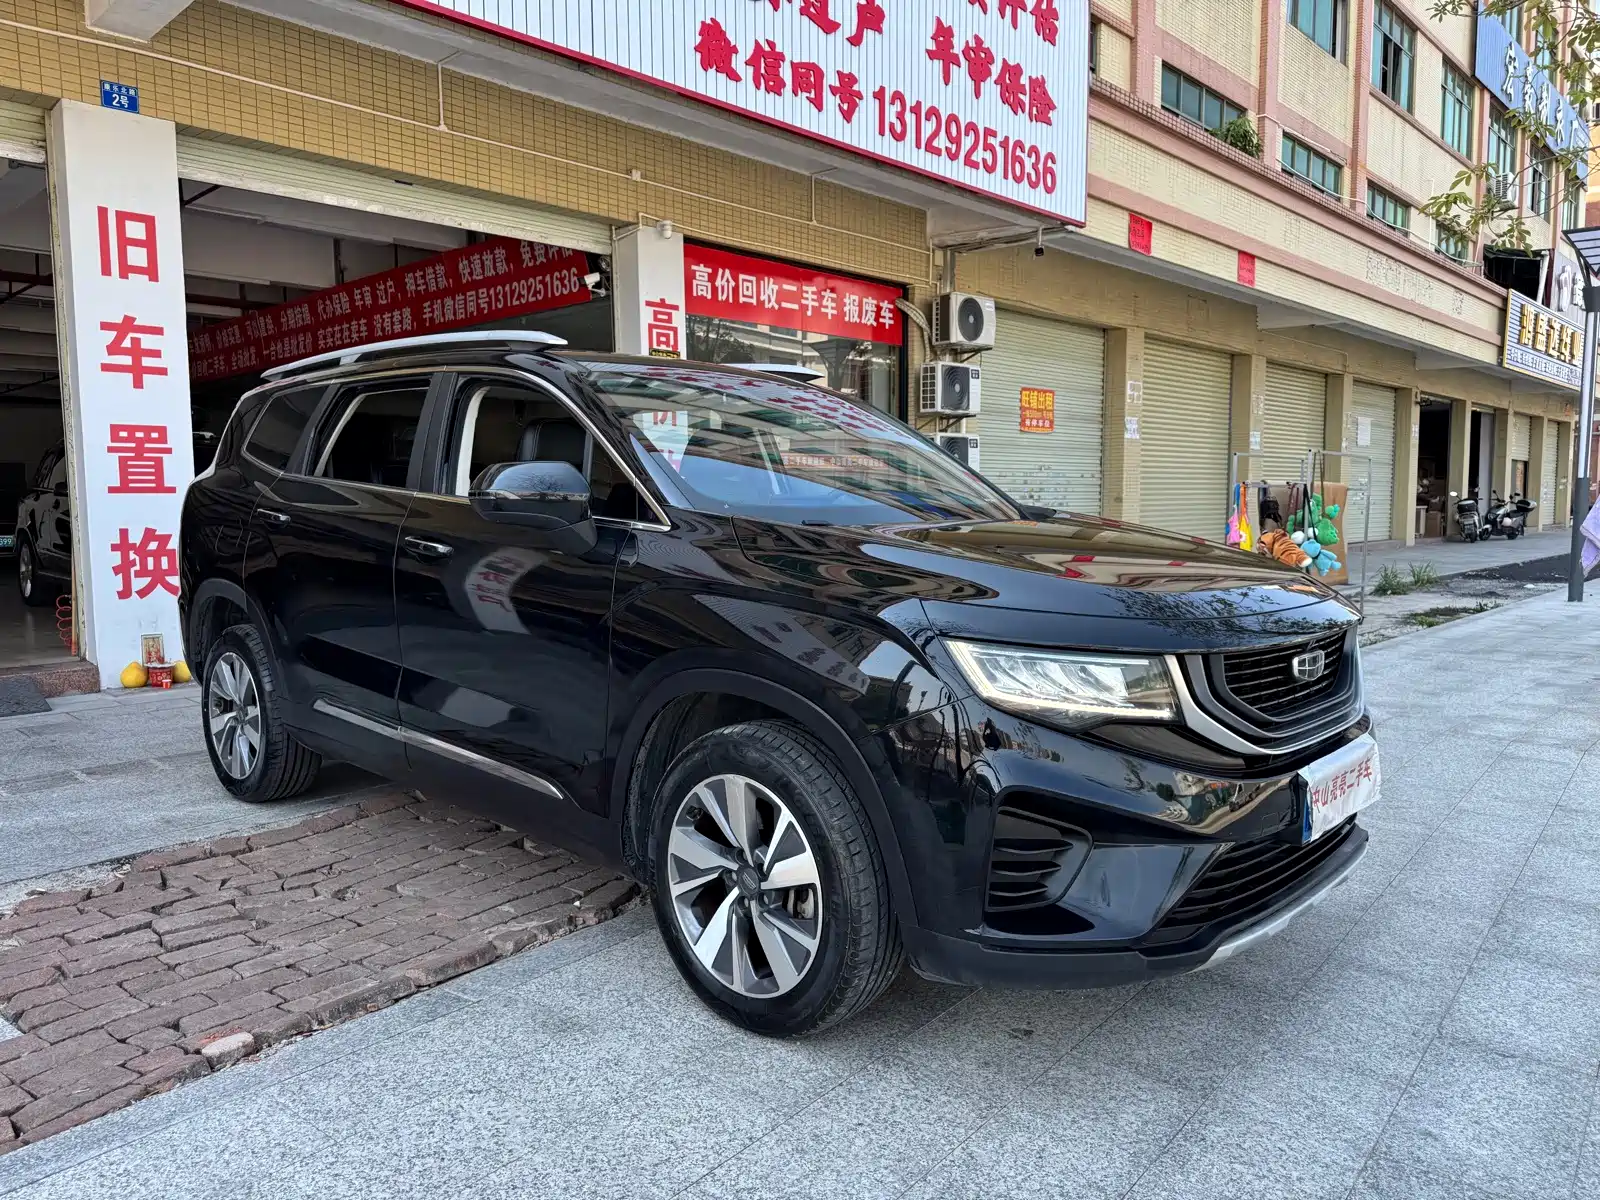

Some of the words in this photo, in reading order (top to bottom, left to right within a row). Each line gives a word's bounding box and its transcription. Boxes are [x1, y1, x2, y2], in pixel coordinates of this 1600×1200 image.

[112, 94, 129, 108] 2号
[927, 16, 1057, 125] 年审保险
[691, 263, 838, 319] 高价回收二手车
[843, 292, 895, 330] 报废车
[97, 205, 180, 601] 旧车置换
[1021, 390, 1053, 410] 旺铺出租
